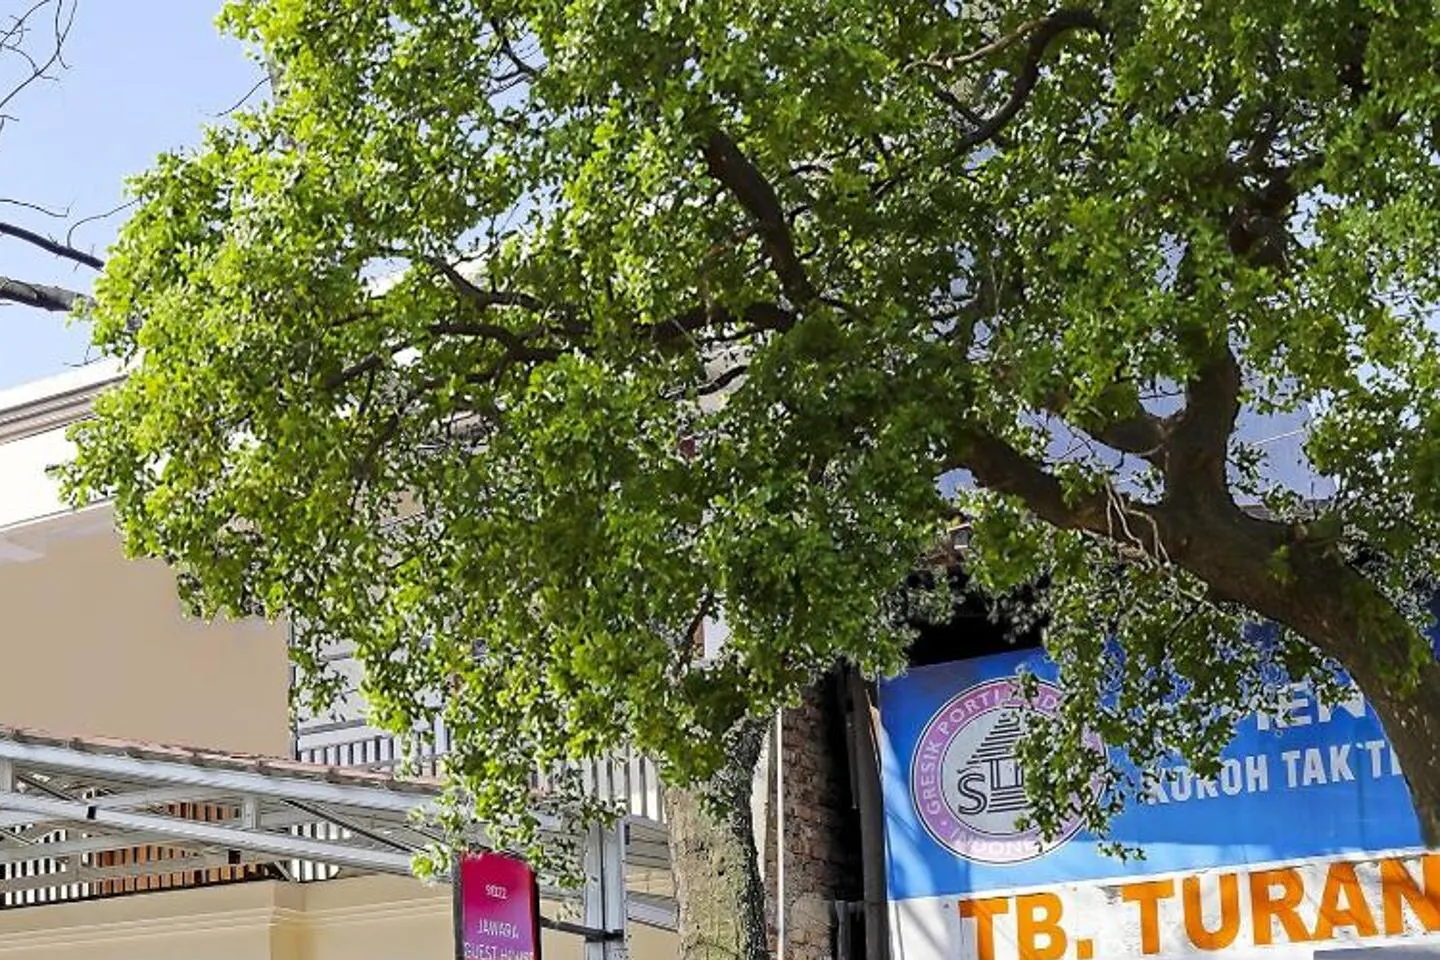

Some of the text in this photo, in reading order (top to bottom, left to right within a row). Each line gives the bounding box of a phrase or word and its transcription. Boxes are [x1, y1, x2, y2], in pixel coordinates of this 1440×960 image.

[921, 741, 943, 815] GRESIK
[1281, 744, 1355, 787] TAK
[464, 942, 497, 960] GUEST
